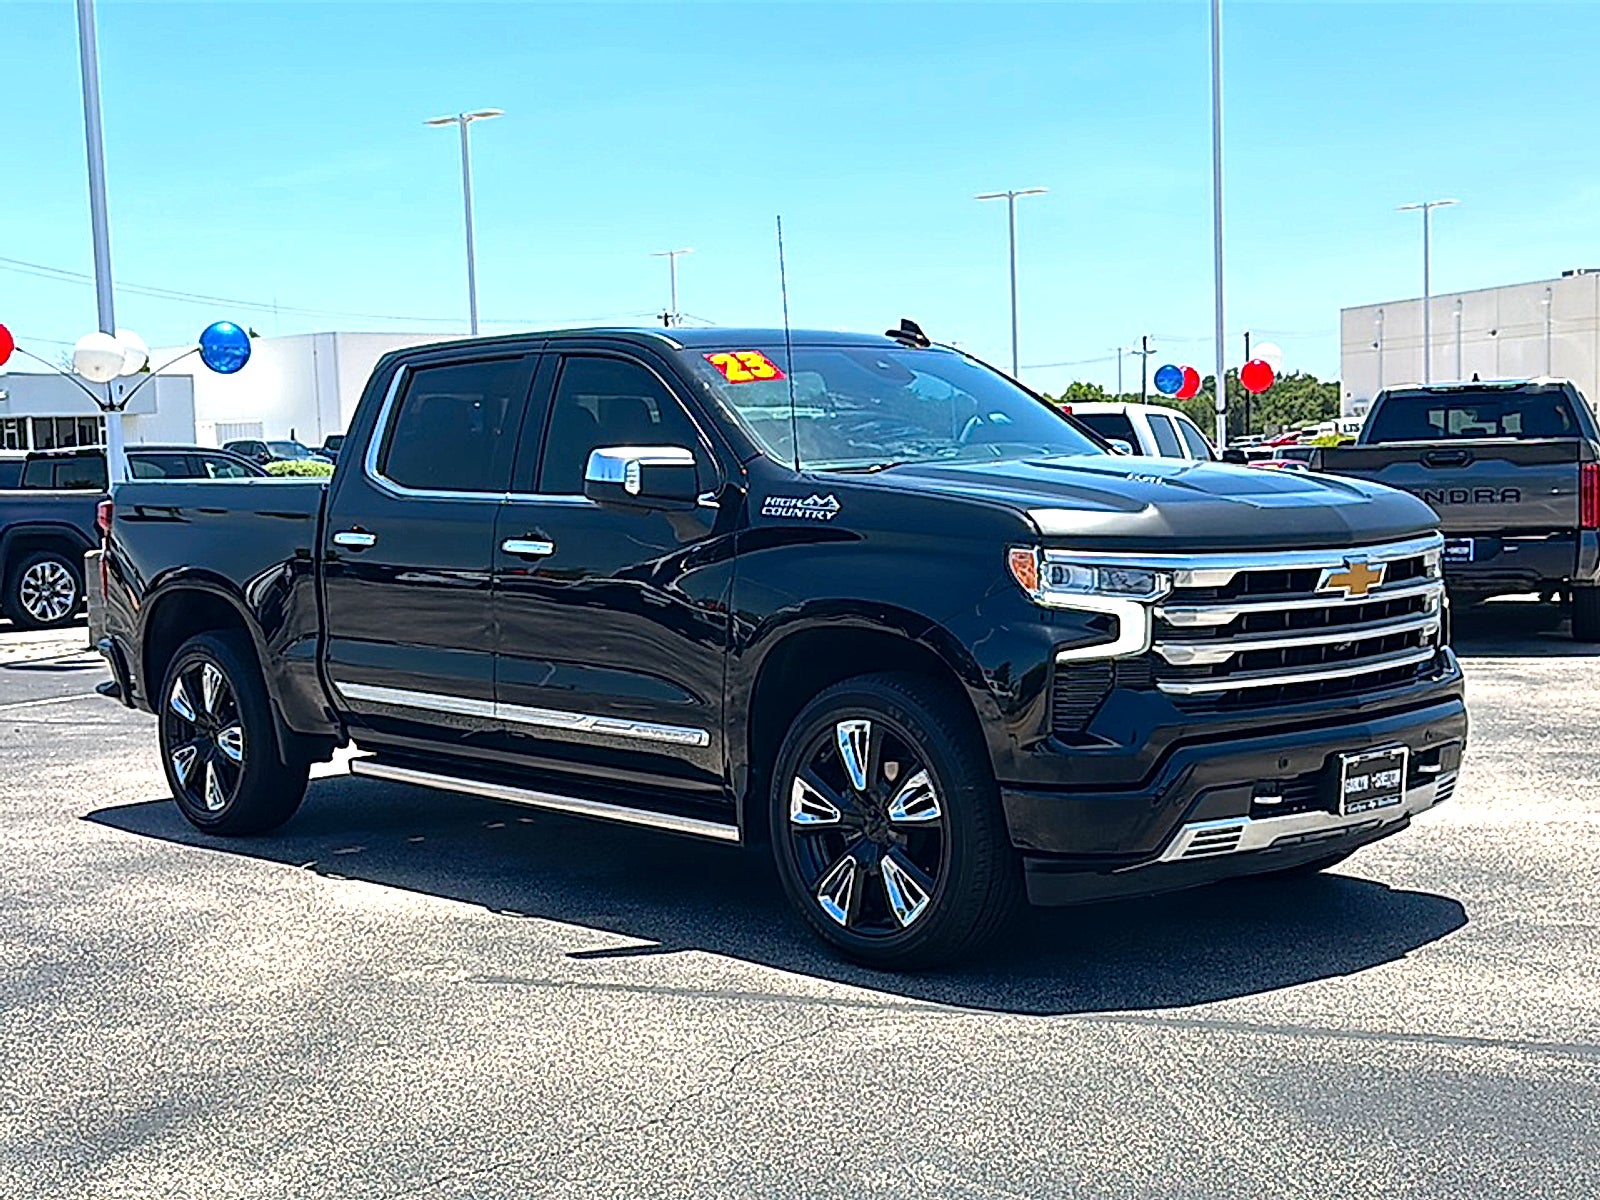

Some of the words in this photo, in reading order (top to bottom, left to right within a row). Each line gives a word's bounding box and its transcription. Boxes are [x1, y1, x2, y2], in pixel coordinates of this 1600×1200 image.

[710, 352, 776, 381] 23
[764, 496, 802, 507] HIGH
[1412, 487, 1521, 504] NDRA
[761, 507, 838, 520] COUNTRY
